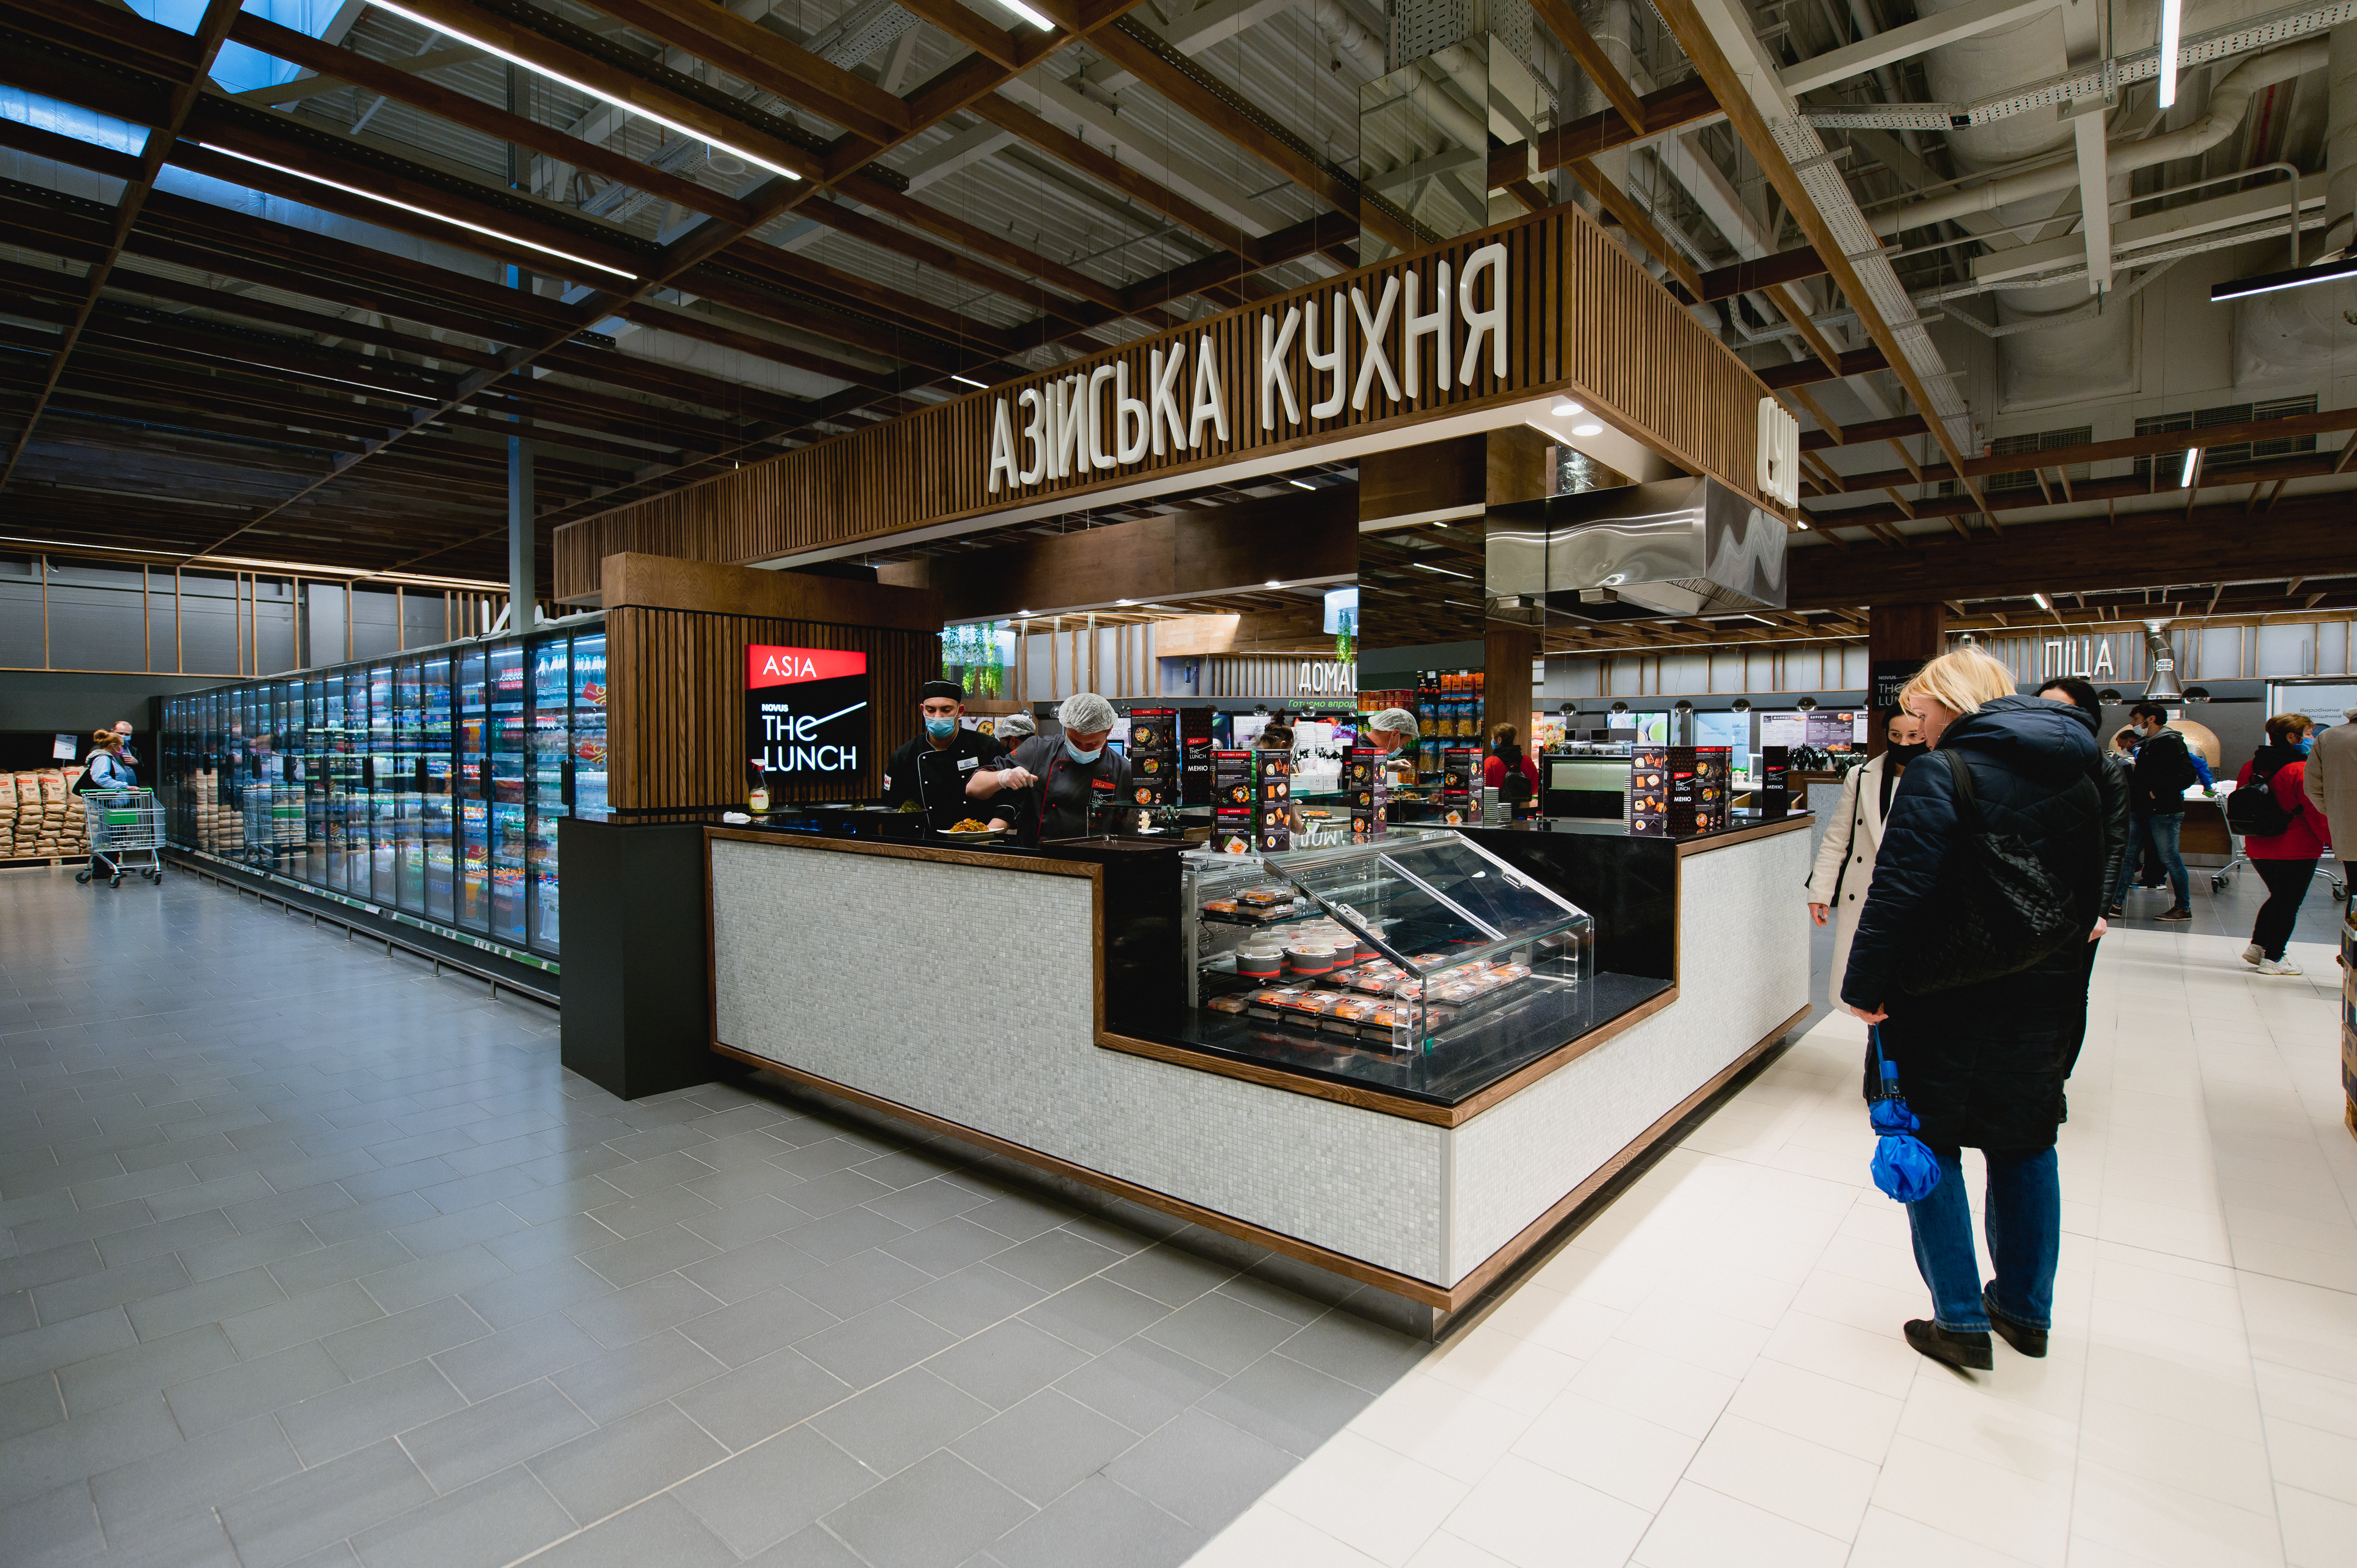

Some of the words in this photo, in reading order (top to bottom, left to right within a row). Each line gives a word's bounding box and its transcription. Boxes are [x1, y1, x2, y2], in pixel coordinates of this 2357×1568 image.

[988, 334, 1230, 494] АЗІЙСЬКА
[1262, 242, 1508, 431] КУХНЯ
[762, 655, 817, 678] ASIA
[2045, 639, 2114, 677] ПІЦА
[761, 704, 788, 712] NOVUS
[764, 746, 856, 772] LUNCH
